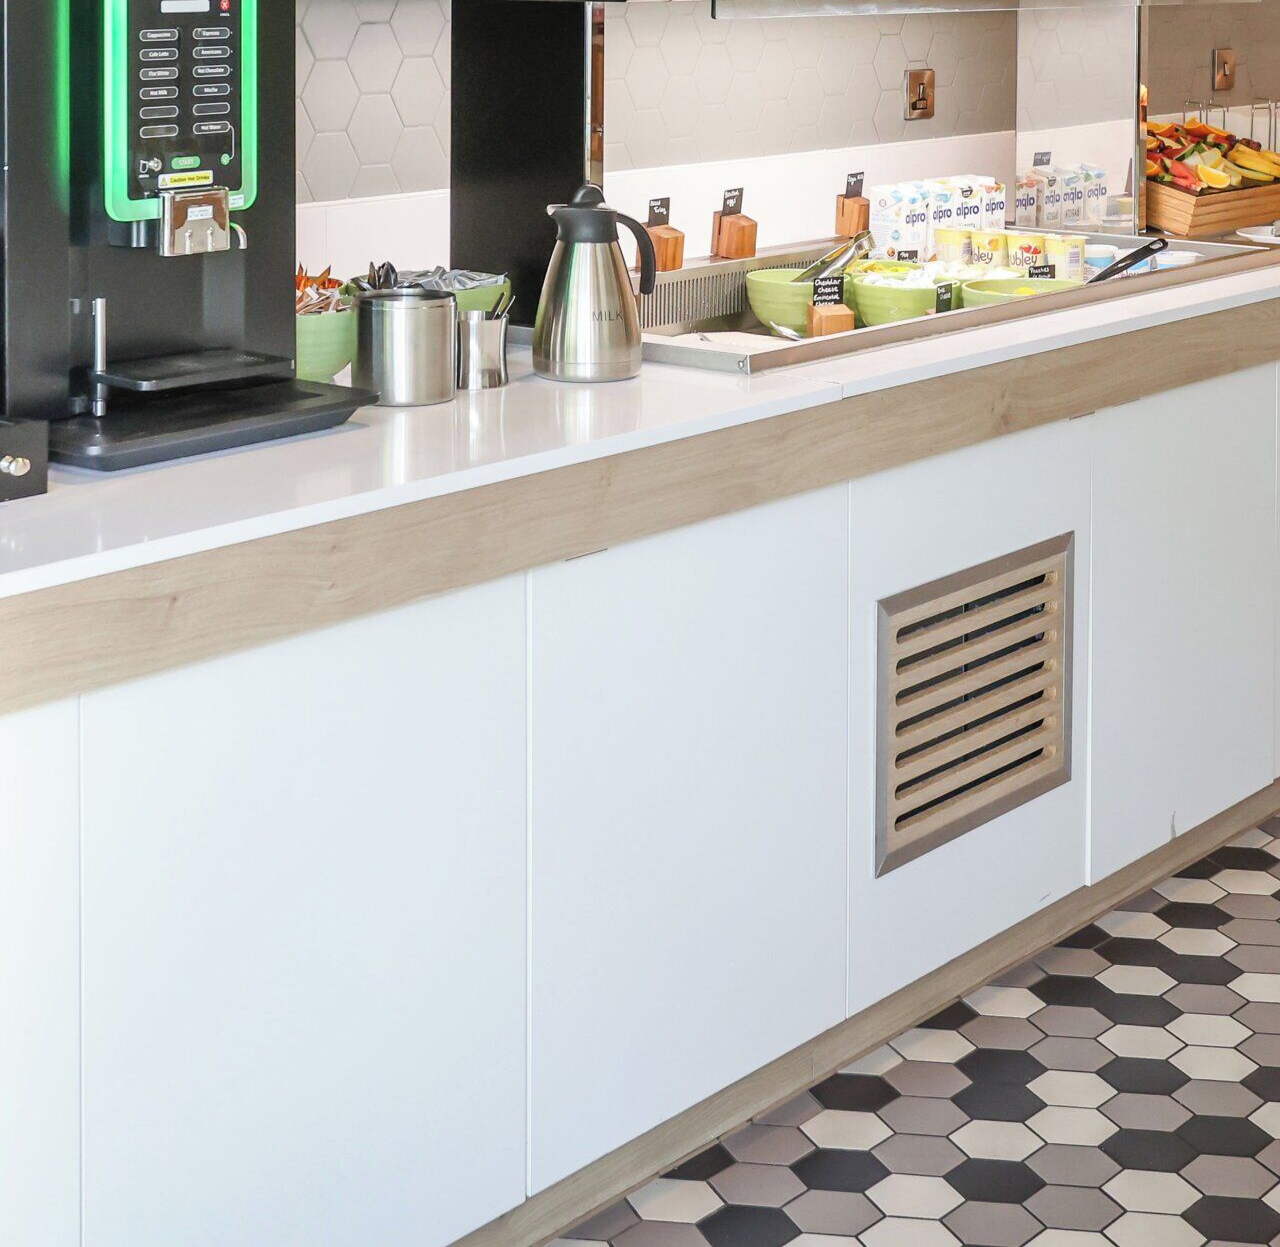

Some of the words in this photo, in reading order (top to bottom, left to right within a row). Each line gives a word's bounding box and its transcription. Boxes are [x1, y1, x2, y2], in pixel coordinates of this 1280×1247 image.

[932, 205, 952, 222] alpro
[956, 202, 980, 219] alpro
[985, 198, 1005, 215] alpro
[905, 210, 926, 227] alpro
[972, 245, 994, 264] bley
[815, 278, 842, 287] Cheddar
[592, 310, 624, 322] MILK
